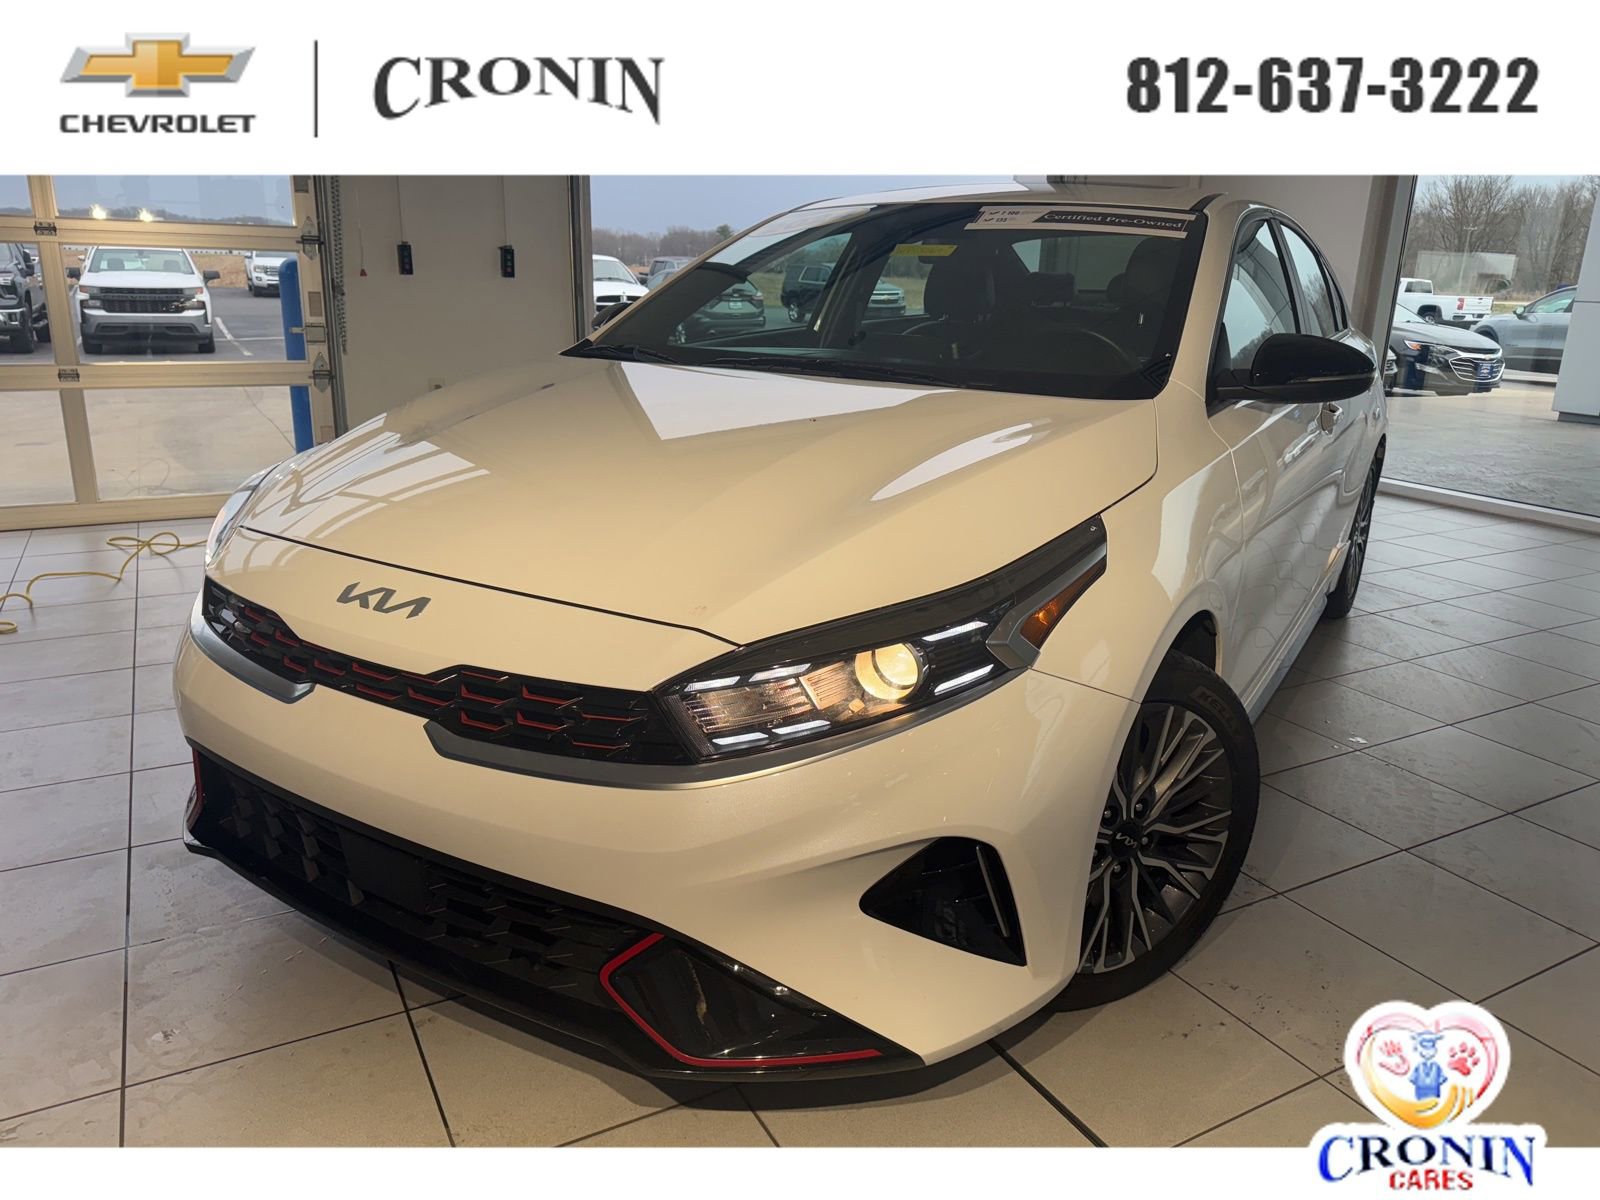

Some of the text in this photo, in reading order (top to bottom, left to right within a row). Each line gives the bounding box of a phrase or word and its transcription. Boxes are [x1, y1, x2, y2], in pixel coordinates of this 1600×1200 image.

[1043, 212, 1103, 223] Certified
[1105, 215, 1183, 229] Pre-Owned
[337, 581, 432, 619] KIA
